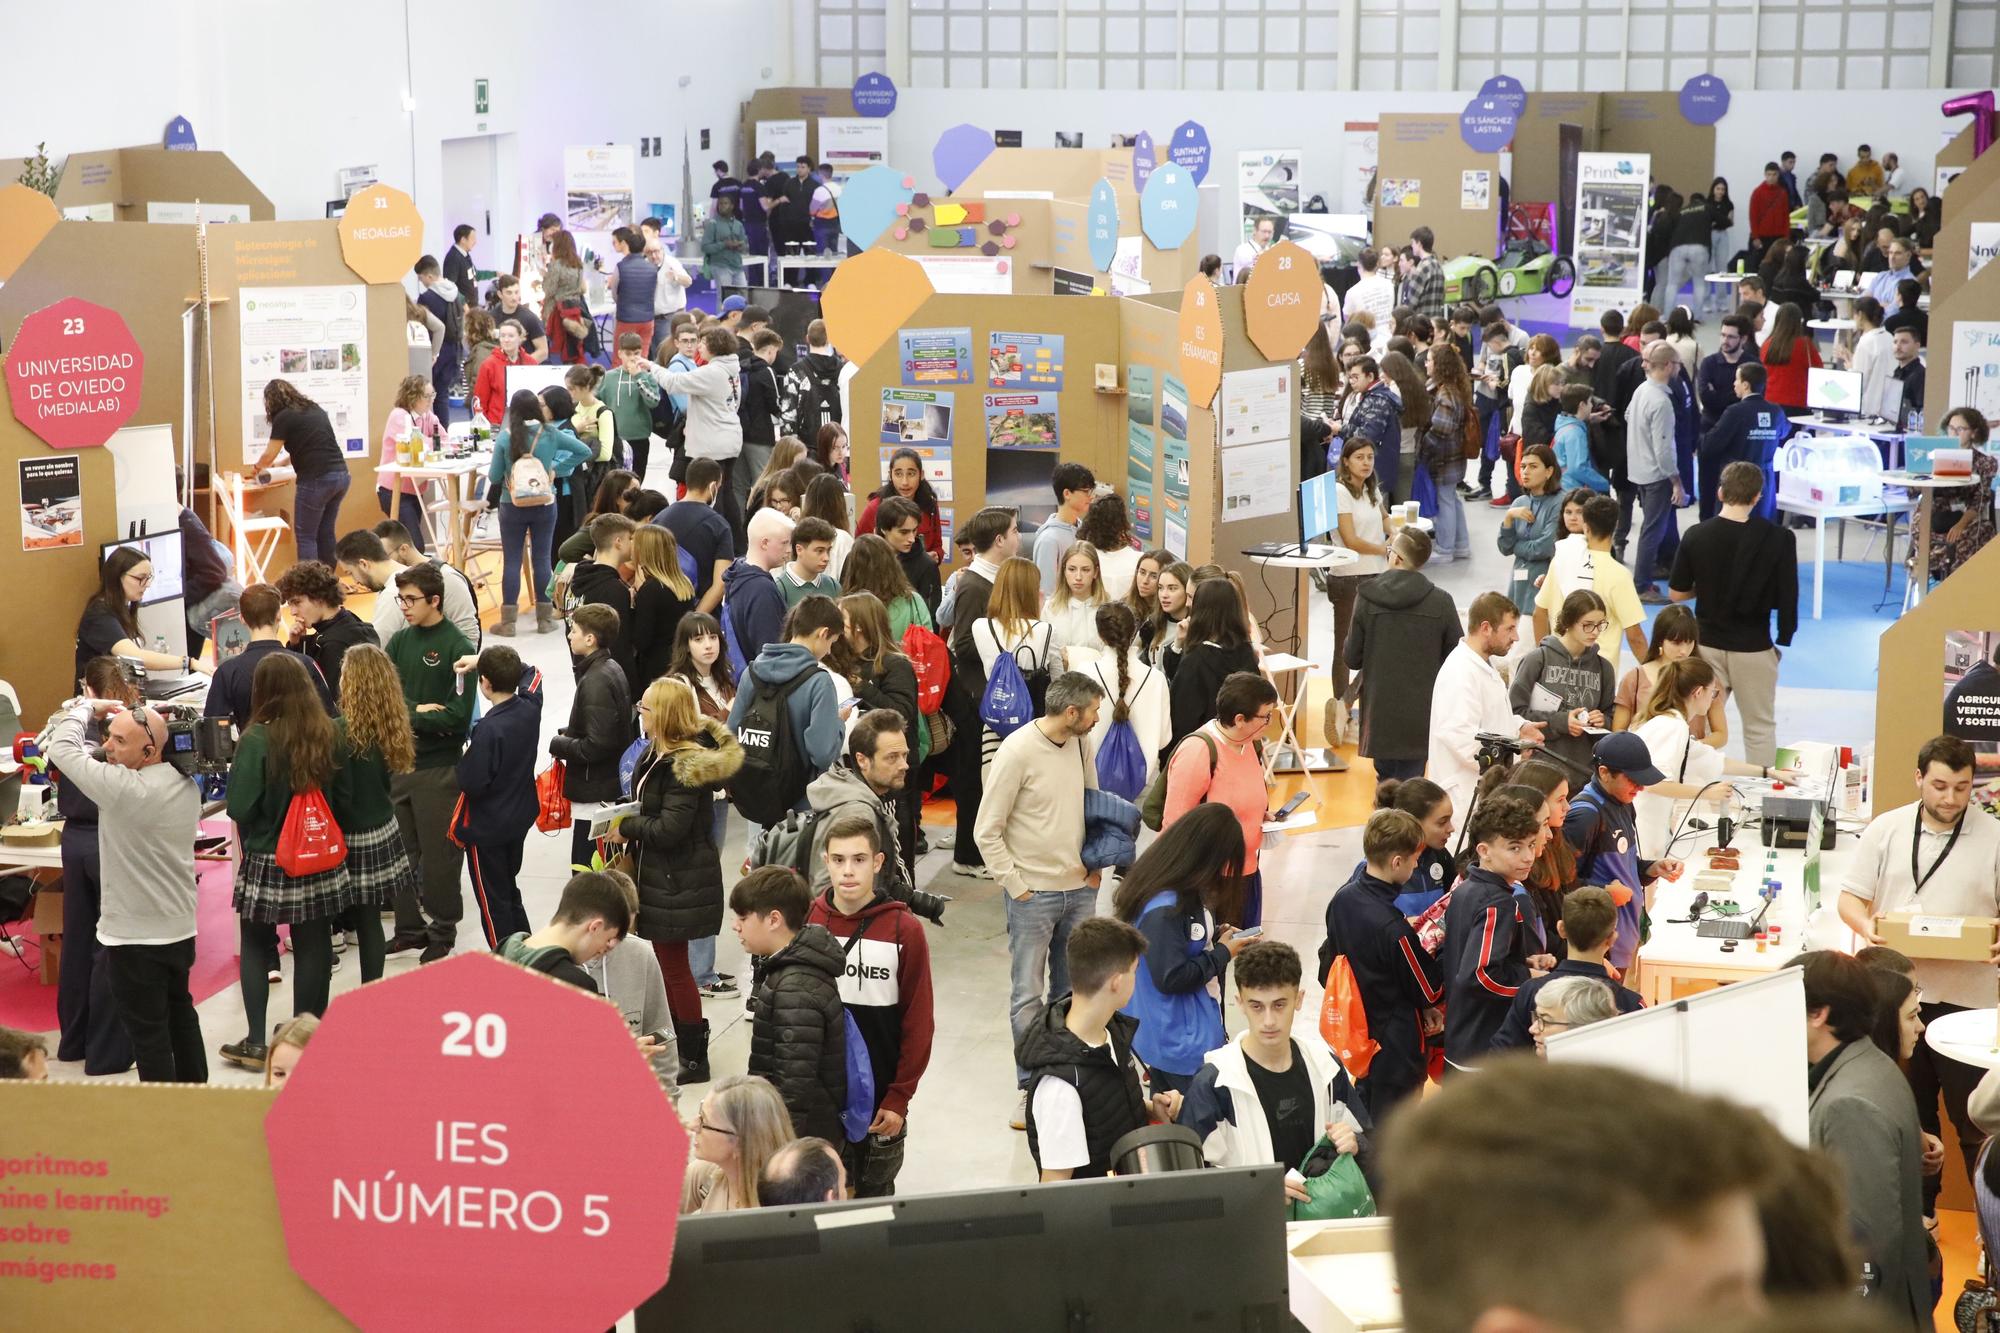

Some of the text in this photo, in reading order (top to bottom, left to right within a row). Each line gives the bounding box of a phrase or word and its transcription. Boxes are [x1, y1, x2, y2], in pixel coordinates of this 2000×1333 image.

[375, 197, 389, 209] 31
[353, 225, 411, 241] NEOALGAE
[1279, 256, 1292, 270] 28
[1196, 291, 1205, 307] 26
[1267, 293, 1301, 308] CAPSA
[63, 318, 84, 335] 23
[1194, 326, 1206, 341] IES
[904, 338, 910, 350] 1
[991, 333, 997, 344] 1
[960, 347, 968, 359] 2
[1182, 340, 1218, 366] PEÑAMAYOR
[18, 353, 133, 377] UNIVERSIDAD
[905, 360, 913, 371] 3
[30, 376, 126, 400] DE OVIEDO
[883, 389, 891, 401] 2
[38, 396, 120, 419] (MEDIALAB)
[985, 396, 993, 407] 3
[1957, 717, 1963, 725] Y
[738, 726, 772, 748] VANS
[846, 964, 890, 980] ONES
[441, 1011, 507, 1058] 20
[435, 1120, 509, 1165] IES
[55, 1187, 171, 1219] learning:
[333, 1169, 611, 1236] NÚMERO 5
